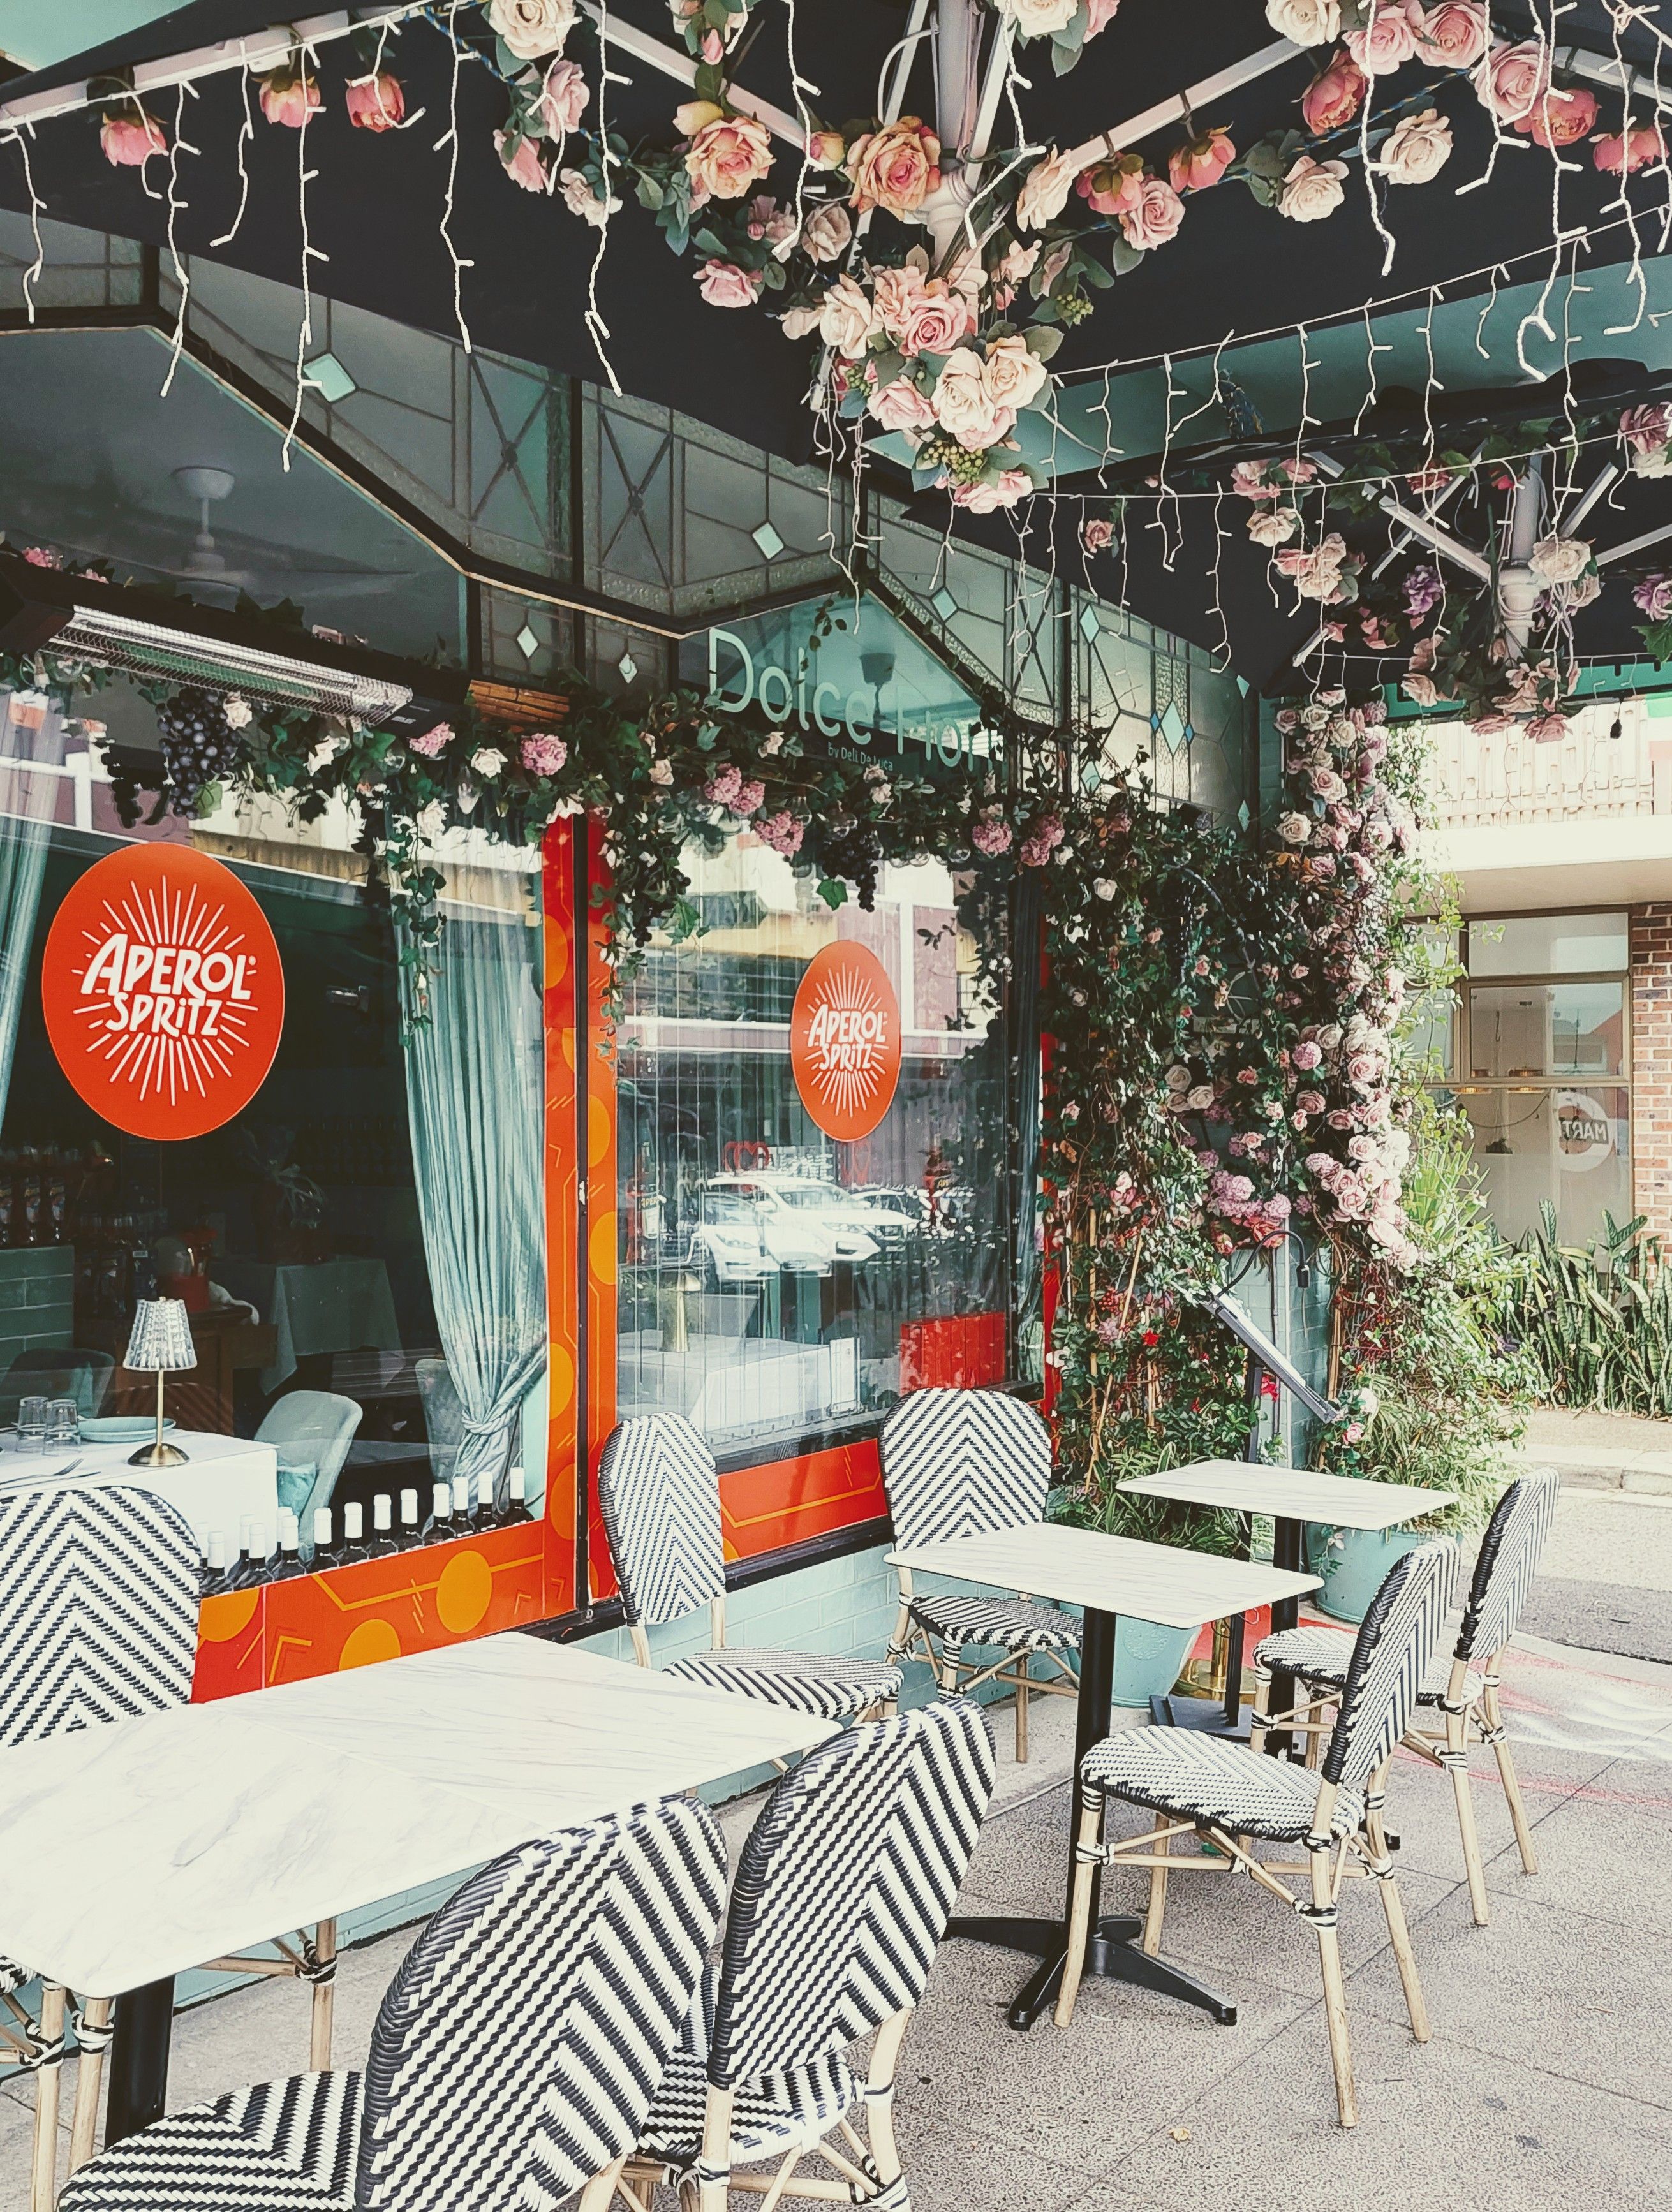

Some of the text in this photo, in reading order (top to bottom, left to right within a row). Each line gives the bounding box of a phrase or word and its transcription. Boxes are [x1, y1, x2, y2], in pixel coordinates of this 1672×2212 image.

[709, 627, 872, 745] Dolce
[841, 746, 859, 763] Deli
[80, 933, 251, 1000] APEROL
[807, 1003, 886, 1047] APEROL
